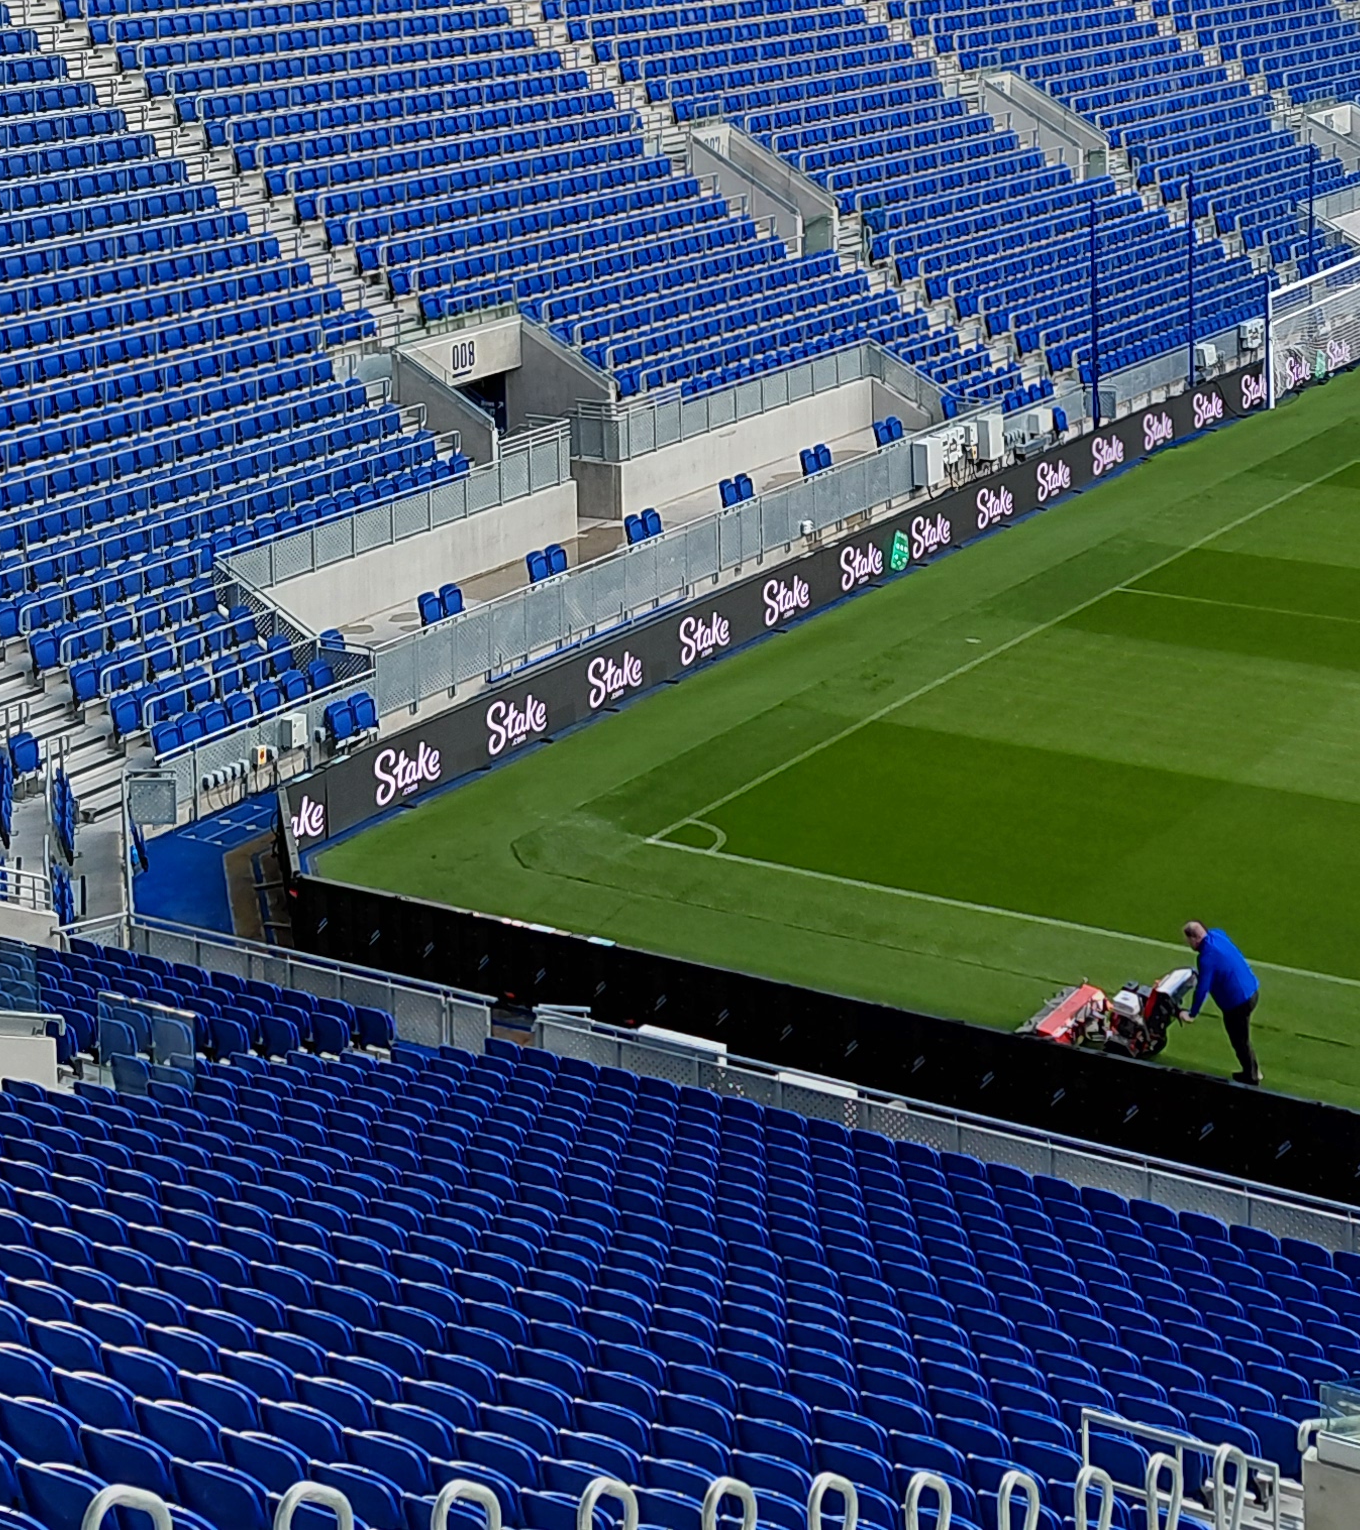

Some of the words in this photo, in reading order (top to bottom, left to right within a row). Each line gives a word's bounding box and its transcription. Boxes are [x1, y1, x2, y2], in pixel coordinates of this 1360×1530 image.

[452, 340, 476, 371] 008
[1143, 412, 1173, 451] Stake
[1193, 392, 1223, 429] Stake
[1092, 435, 1124, 476] Stake
[1037, 460, 1071, 502] Stake
[976, 486, 1013, 530] Stake
[911, 513, 951, 559] Stake
[840, 542, 883, 591] Stake
[763, 575, 810, 627] Stake
[679, 611, 730, 666] Stake
[587, 651, 642, 709] Stake
[487, 694, 547, 755] Stake
[375, 741, 441, 807] Stake
